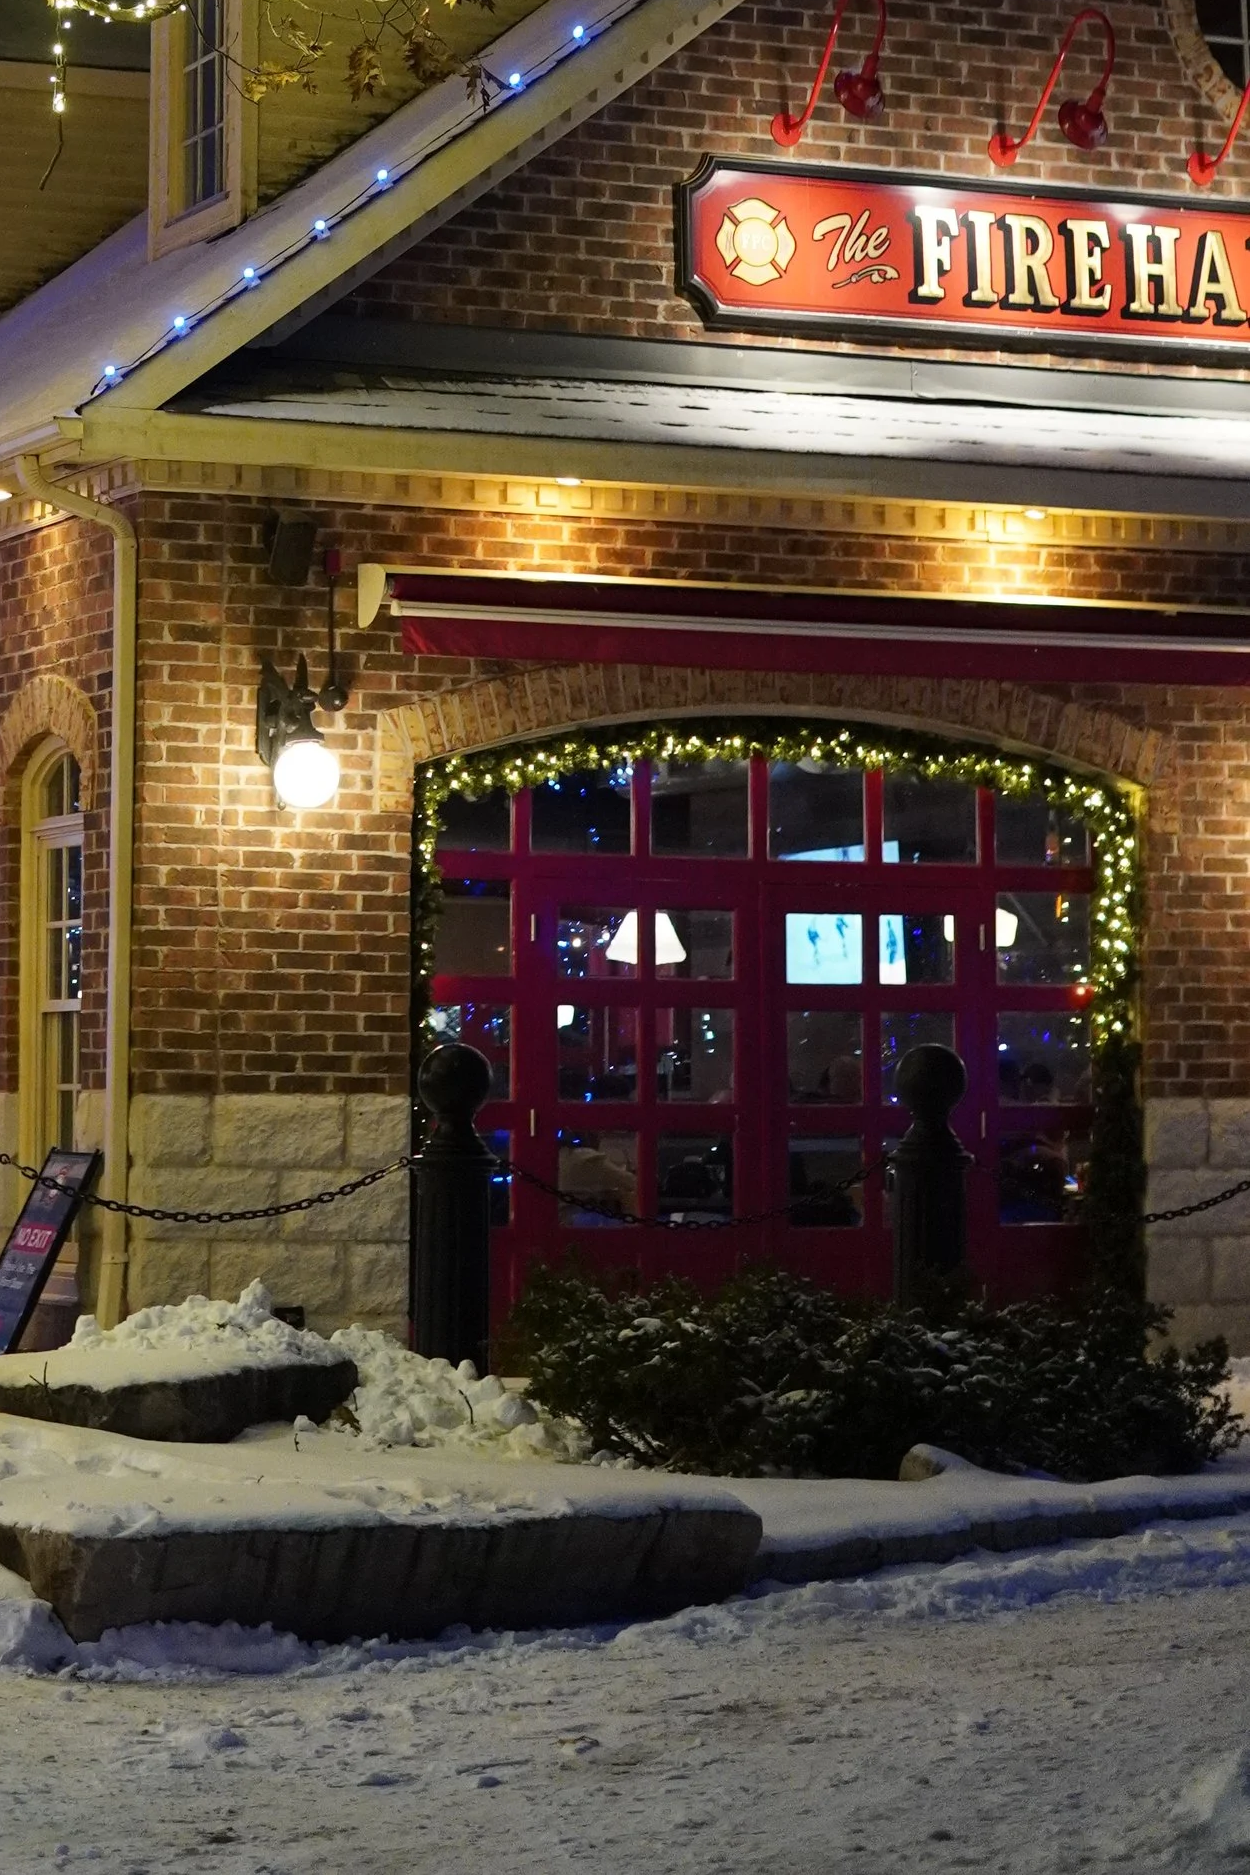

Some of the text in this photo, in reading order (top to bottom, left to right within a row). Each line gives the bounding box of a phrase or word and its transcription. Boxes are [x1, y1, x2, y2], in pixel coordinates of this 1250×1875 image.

[812, 205, 1250, 327] The FIREHA
[15, 1227, 53, 1249] NO EXIT
